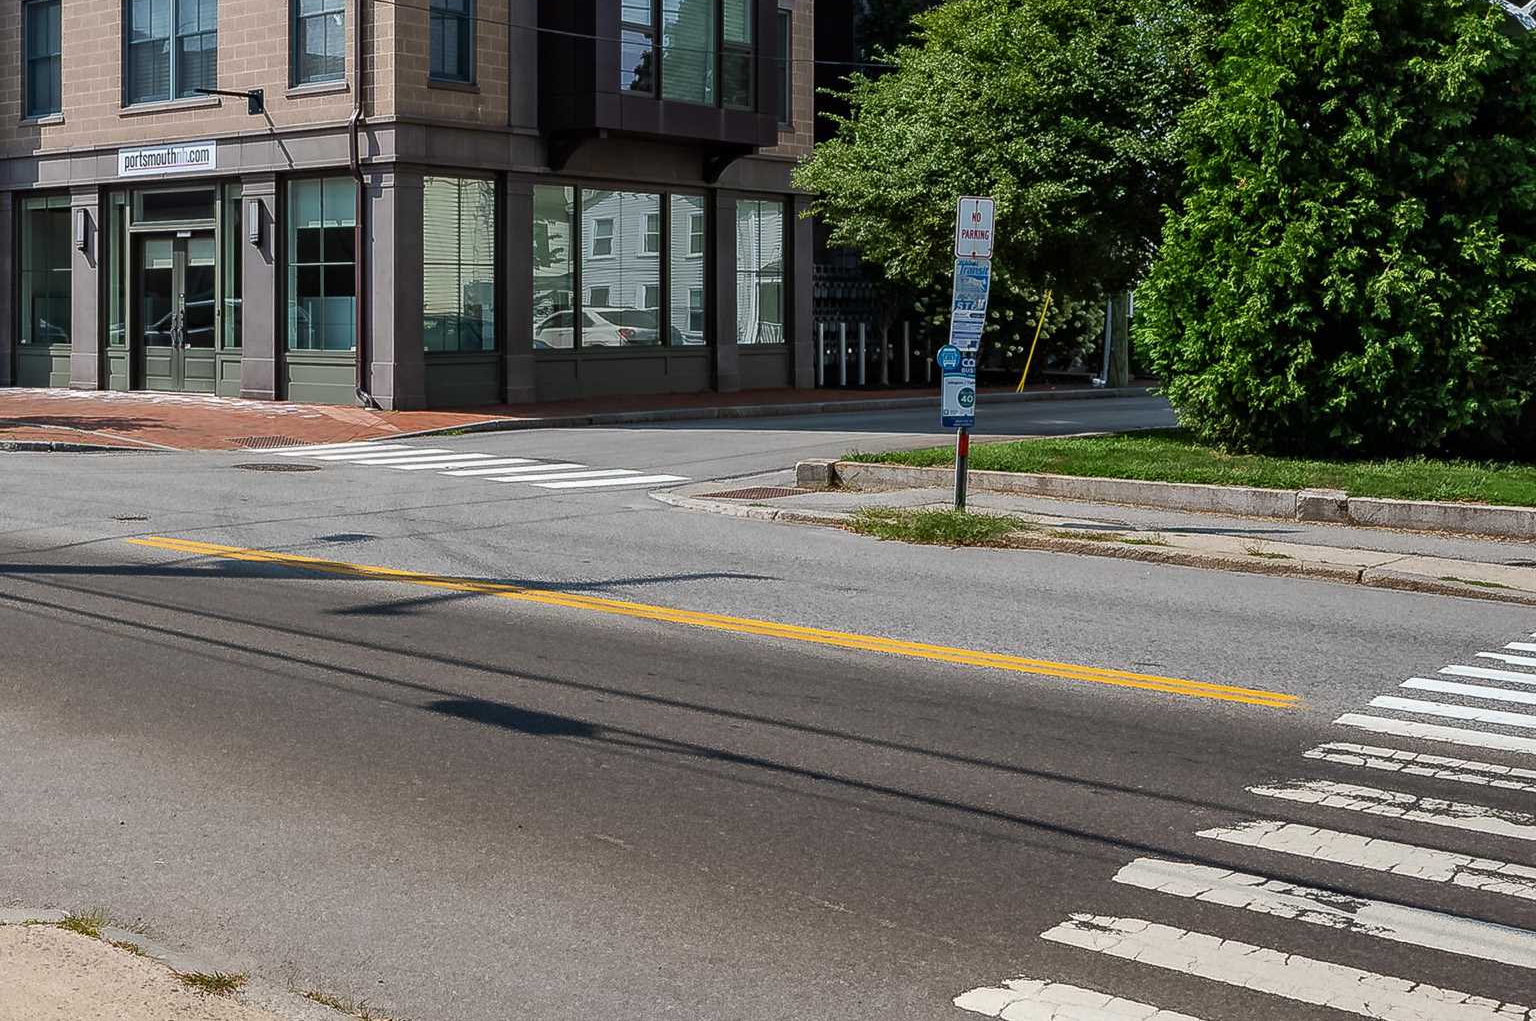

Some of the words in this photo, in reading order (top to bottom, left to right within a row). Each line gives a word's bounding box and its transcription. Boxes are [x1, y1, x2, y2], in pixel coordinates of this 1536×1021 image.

[971, 212, 982, 223] NO
[961, 229, 990, 241] PARKING
[960, 395, 973, 403] 40
